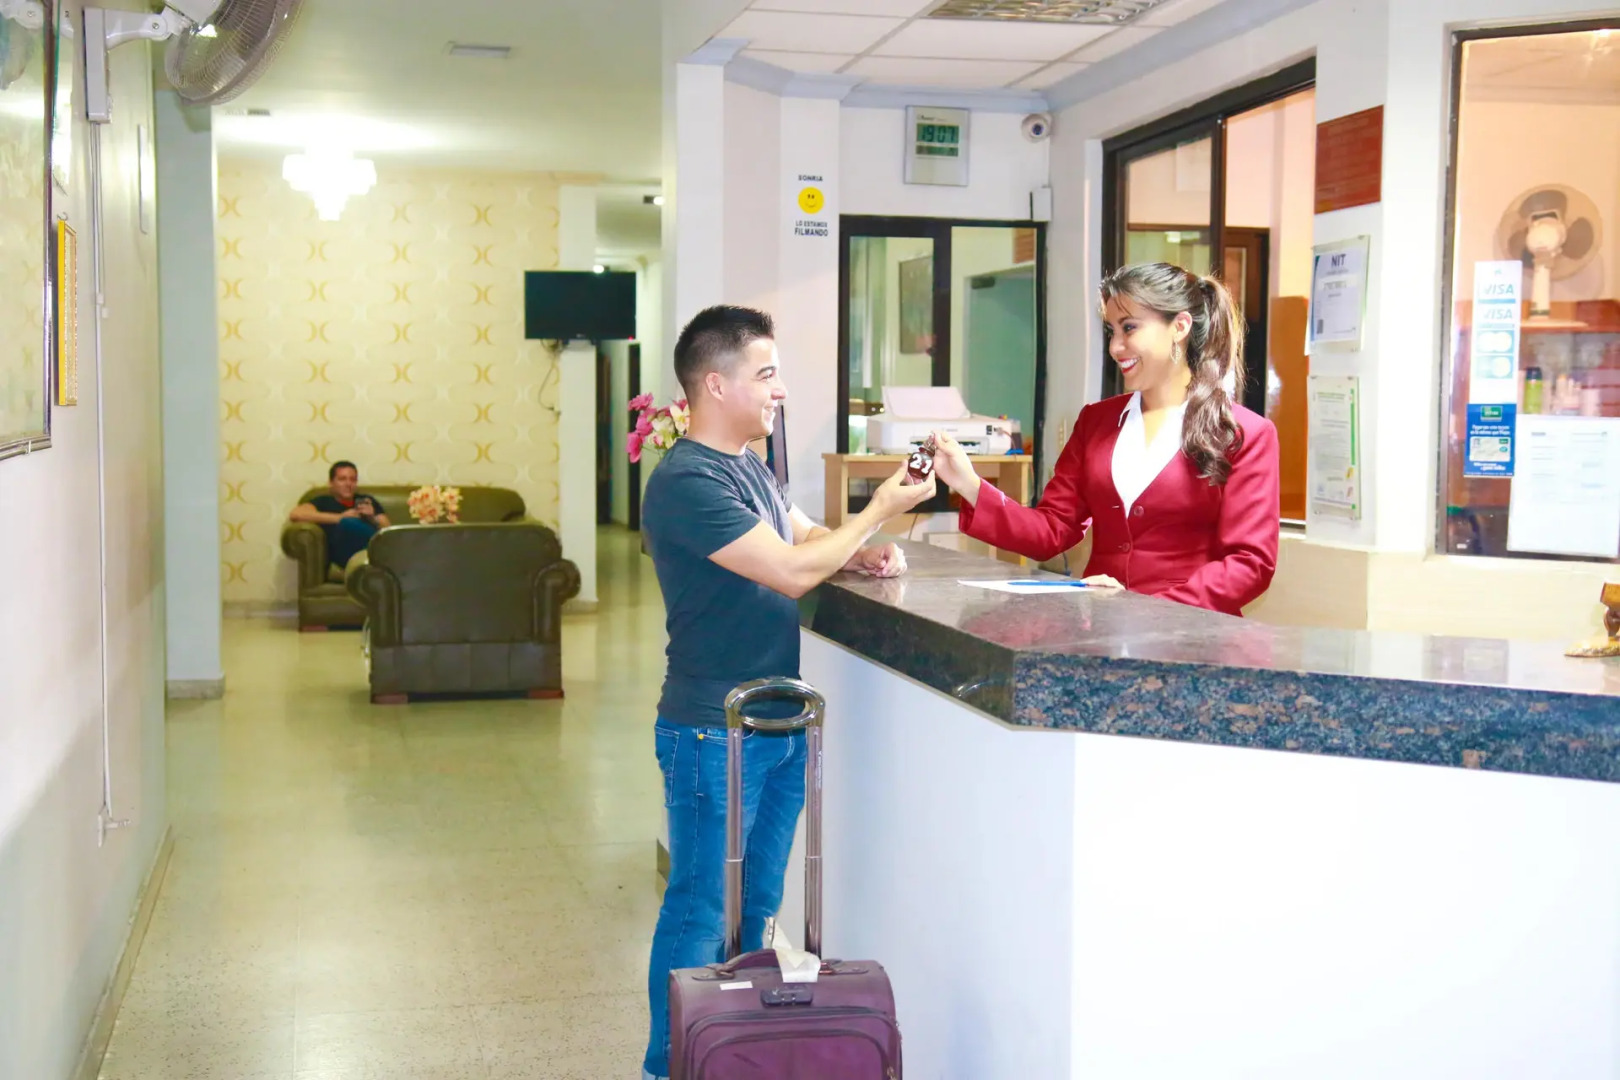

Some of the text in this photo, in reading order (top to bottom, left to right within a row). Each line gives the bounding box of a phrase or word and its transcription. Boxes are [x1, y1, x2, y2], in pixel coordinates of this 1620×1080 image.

[794, 227, 828, 236] FILMANDO
[1331, 253, 1346, 268] NIT
[910, 453, 932, 474] 21
